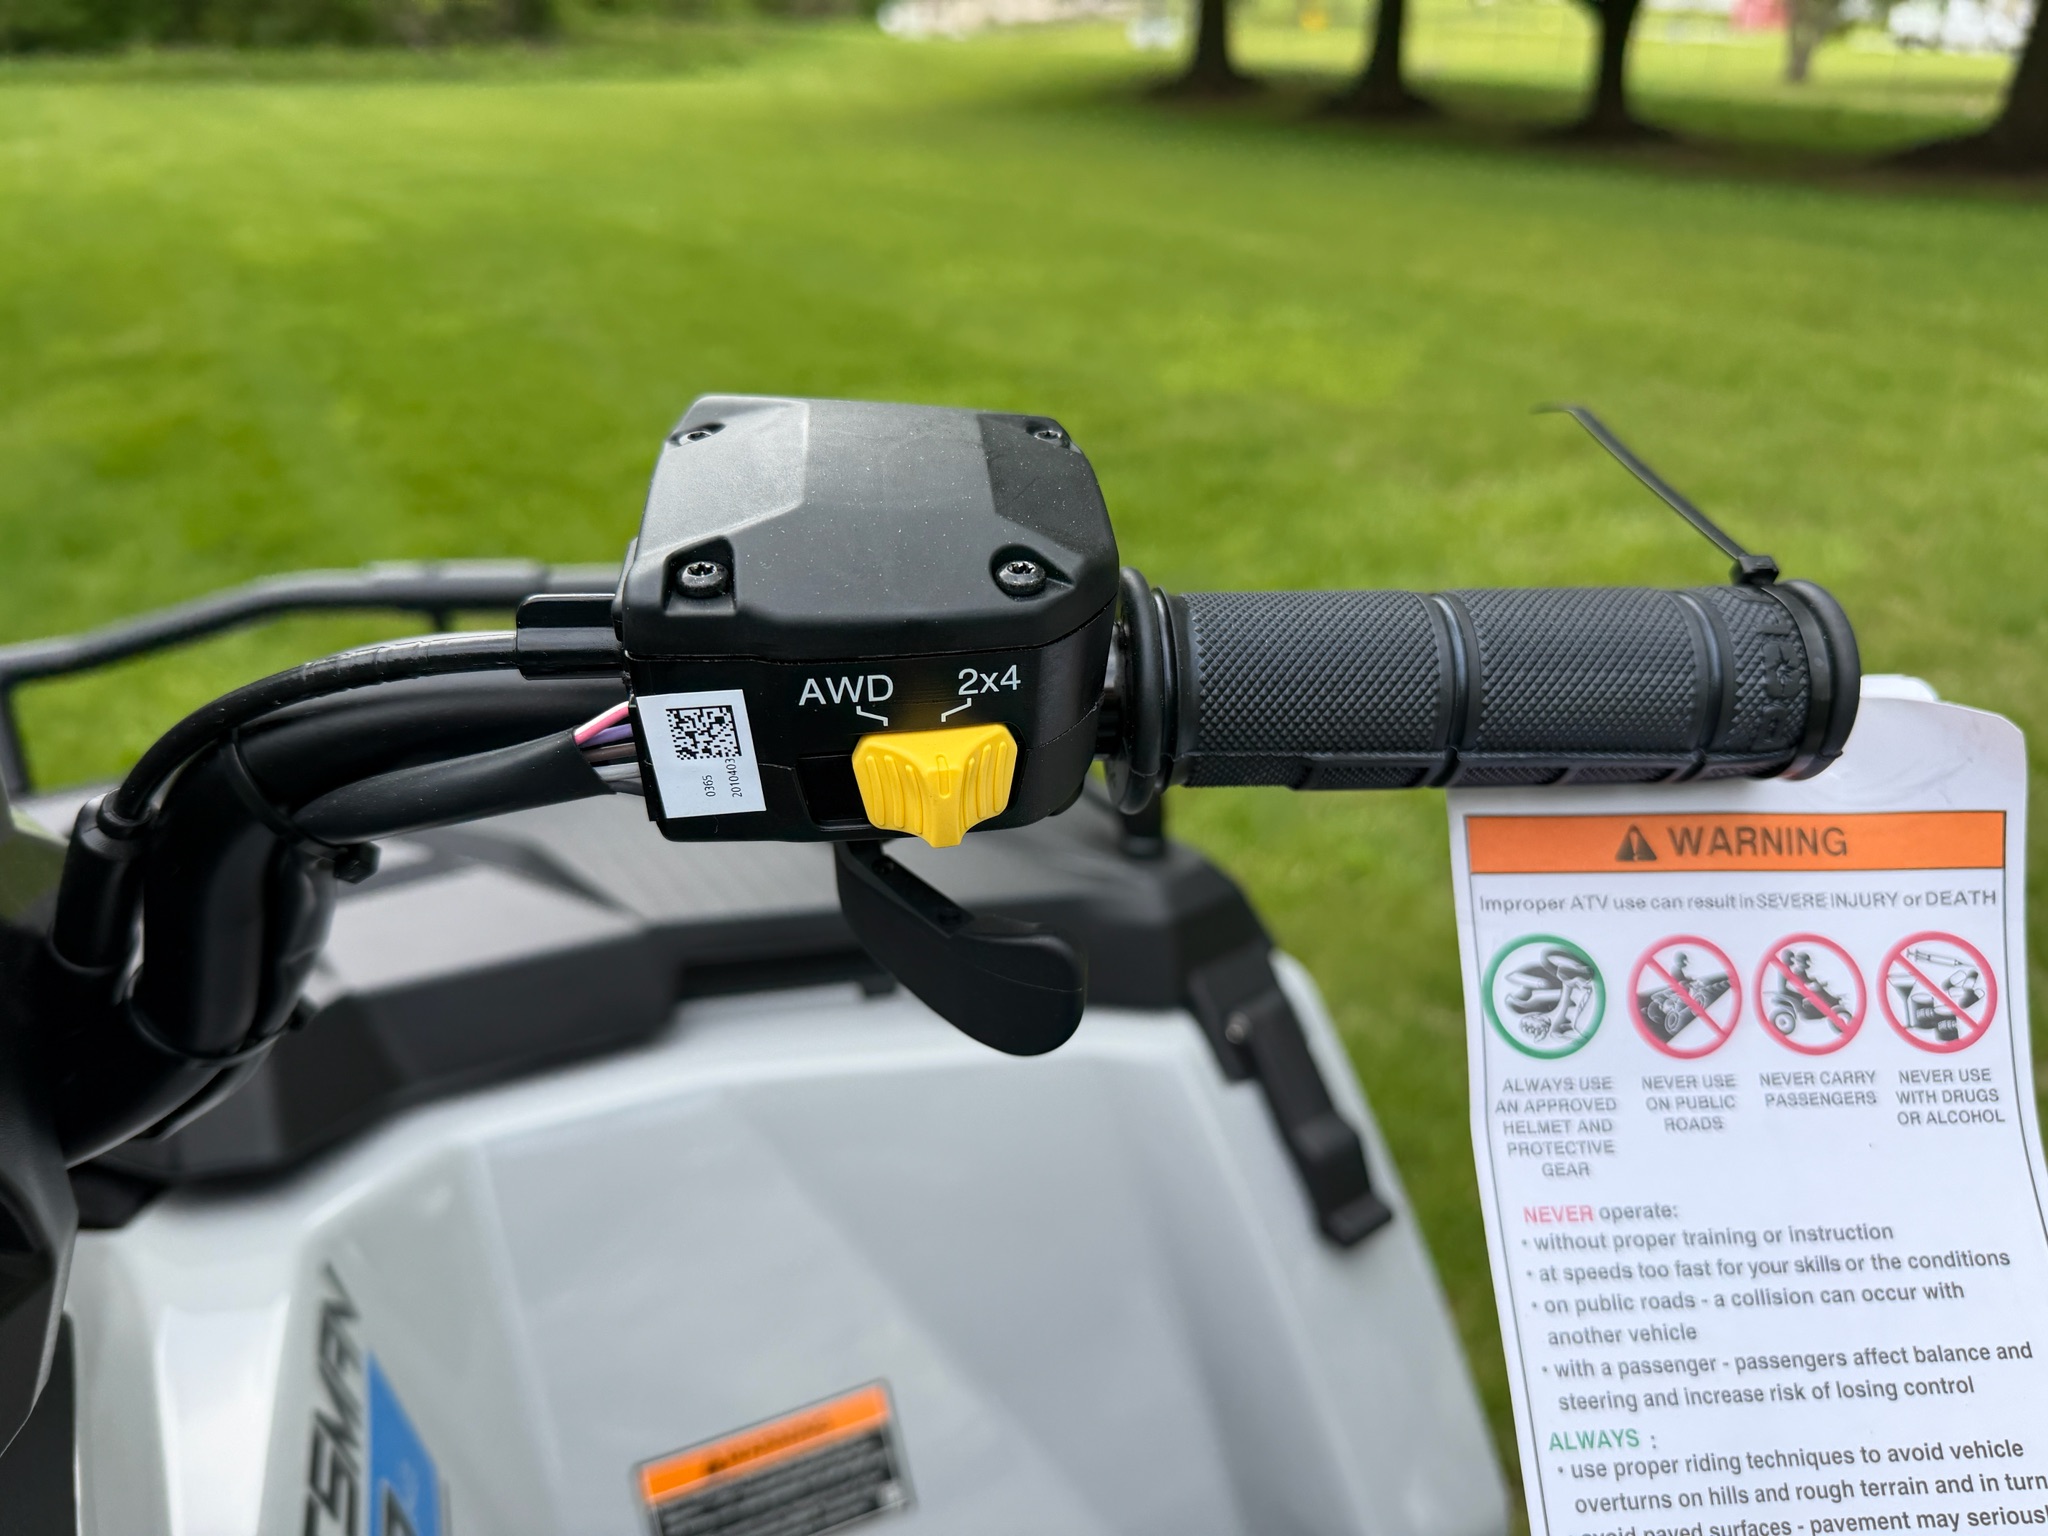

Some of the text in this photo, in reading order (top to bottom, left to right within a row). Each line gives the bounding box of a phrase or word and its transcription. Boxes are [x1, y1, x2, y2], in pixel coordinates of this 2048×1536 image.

[798, 674, 894, 707] AWD
[957, 664, 1022, 696] 2x4
[702, 775, 716, 797] 0365
[725, 758, 743, 797] 2010403
[1667, 827, 1848, 857] WARNING
[1480, 890, 1996, 914] Improper ATV use can result in SEVERE INJURY or DEATH
[1502, 1076, 1613, 1093] ALWAYS USE
[1642, 1074, 1737, 1090] NEVER USE
[1759, 1070, 1876, 1087] NEVER CARRY
[1898, 1068, 1991, 1084] NEVER USE
[1495, 1097, 1617, 1114] AN APPROVED
[1645, 1095, 1736, 1112] ON PUBLIC
[1764, 1090, 1877, 1107] PASSENGERS
[1895, 1089, 1999, 1105] WITH DRUGS
[1503, 1118, 1613, 1136] HELMET AND
[1664, 1116, 1724, 1132] ROADS
[1897, 1109, 2005, 1126] OR ALCOHOL
[1507, 1139, 1615, 1156] PROTECTIVE
[1542, 1162, 1590, 1177] GEAR
[1523, 1202, 1678, 1224] NEVER operate:
[1534, 1223, 1894, 1251] without proper training or instruction
[1539, 1250, 2011, 1284] at speeds too fast for your skills or the conditions
[1544, 1299, 1568, 1314] on
[1575, 1294, 1635, 1316] public
[1641, 1292, 1695, 1310] roads
[1714, 1293, 1725, 1307] a
[1731, 1286, 1814, 1307] collision
[1820, 1287, 1854, 1304] can
[1861, 1285, 1917, 1302] occur
[1923, 1281, 1965, 1299] with
[1548, 1323, 1697, 1345] another vehicle
[1554, 1359, 1595, 1378] with
[1601, 1361, 1612, 1376] a
[1618, 1356, 1717, 1380] passenger
[1735, 1351, 1847, 1375] passengers
[1853, 1347, 1909, 1366] affect
[1913, 1344, 1991, 1364] balance
[1997, 1342, 2033, 1360] and
[1559, 1375, 1975, 1413] steering and increase risk of losing control
[1549, 1428, 1640, 1451] ALWAYS
[1571, 1439, 2024, 1481] use proper riding techniques to avoid vehicle
[1575, 1492, 1672, 1513] overturns
[1678, 1491, 1703, 1508] on
[1708, 1485, 1749, 1506] hills
[1755, 1482, 1790, 1503] and
[1795, 1480, 1855, 1503] rough
[1860, 1476, 1929, 1497] terrain
[1935, 1473, 1974, 1494] and
[1979, 1473, 1999, 1492] in
[1810, 1511, 1911, 1536] pavement
[1916, 1511, 1960, 1532] may
